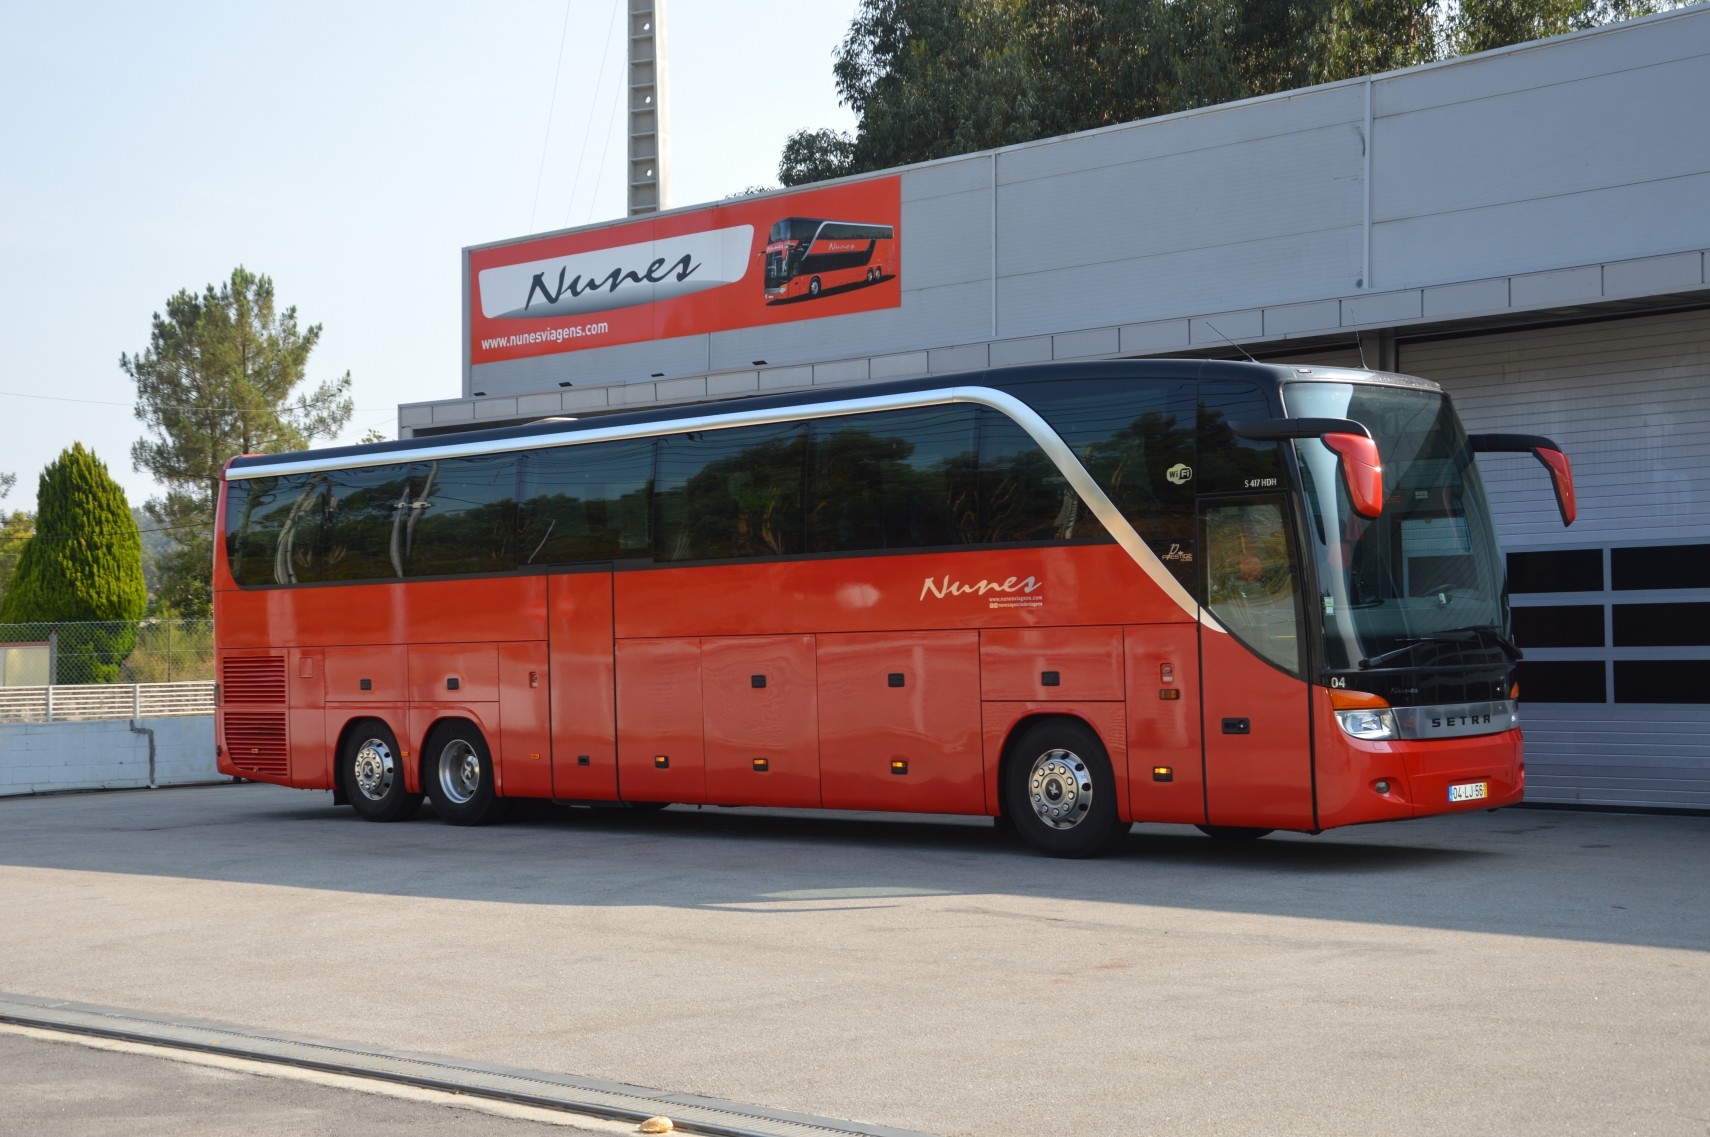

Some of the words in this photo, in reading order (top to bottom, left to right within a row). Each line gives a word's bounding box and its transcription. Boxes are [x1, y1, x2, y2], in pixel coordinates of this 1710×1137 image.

[524, 253, 702, 311] Nunes
[481, 321, 609, 350] www.nunesviagens.com
[1244, 479, 1249, 488] S
[1249, 478, 1260, 487] 417
[1261, 477, 1277, 487] HDH
[920, 574, 1042, 602] Nunes
[1331, 677, 1346, 688] 04
[1431, 714, 1491, 728] SETRA
